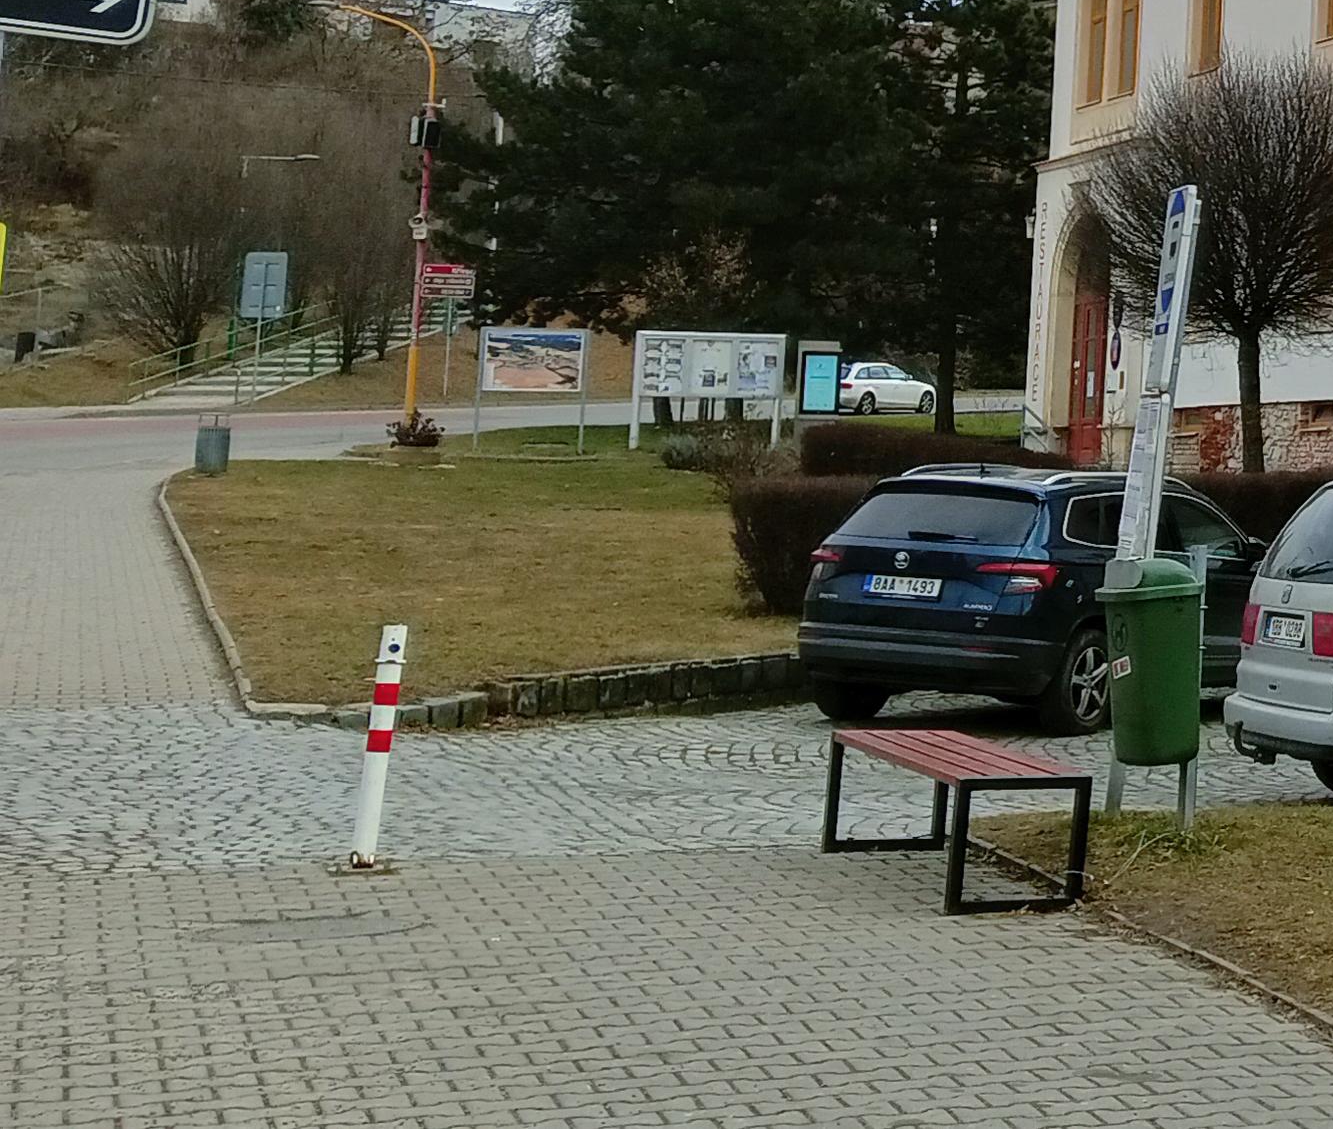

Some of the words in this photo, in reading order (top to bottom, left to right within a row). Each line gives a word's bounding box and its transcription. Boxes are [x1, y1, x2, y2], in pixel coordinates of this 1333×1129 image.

[1031, 202, 1048, 402] RESTAURACE
[873, 577, 896, 591] 8AA
[905, 580, 935, 594] 1493
